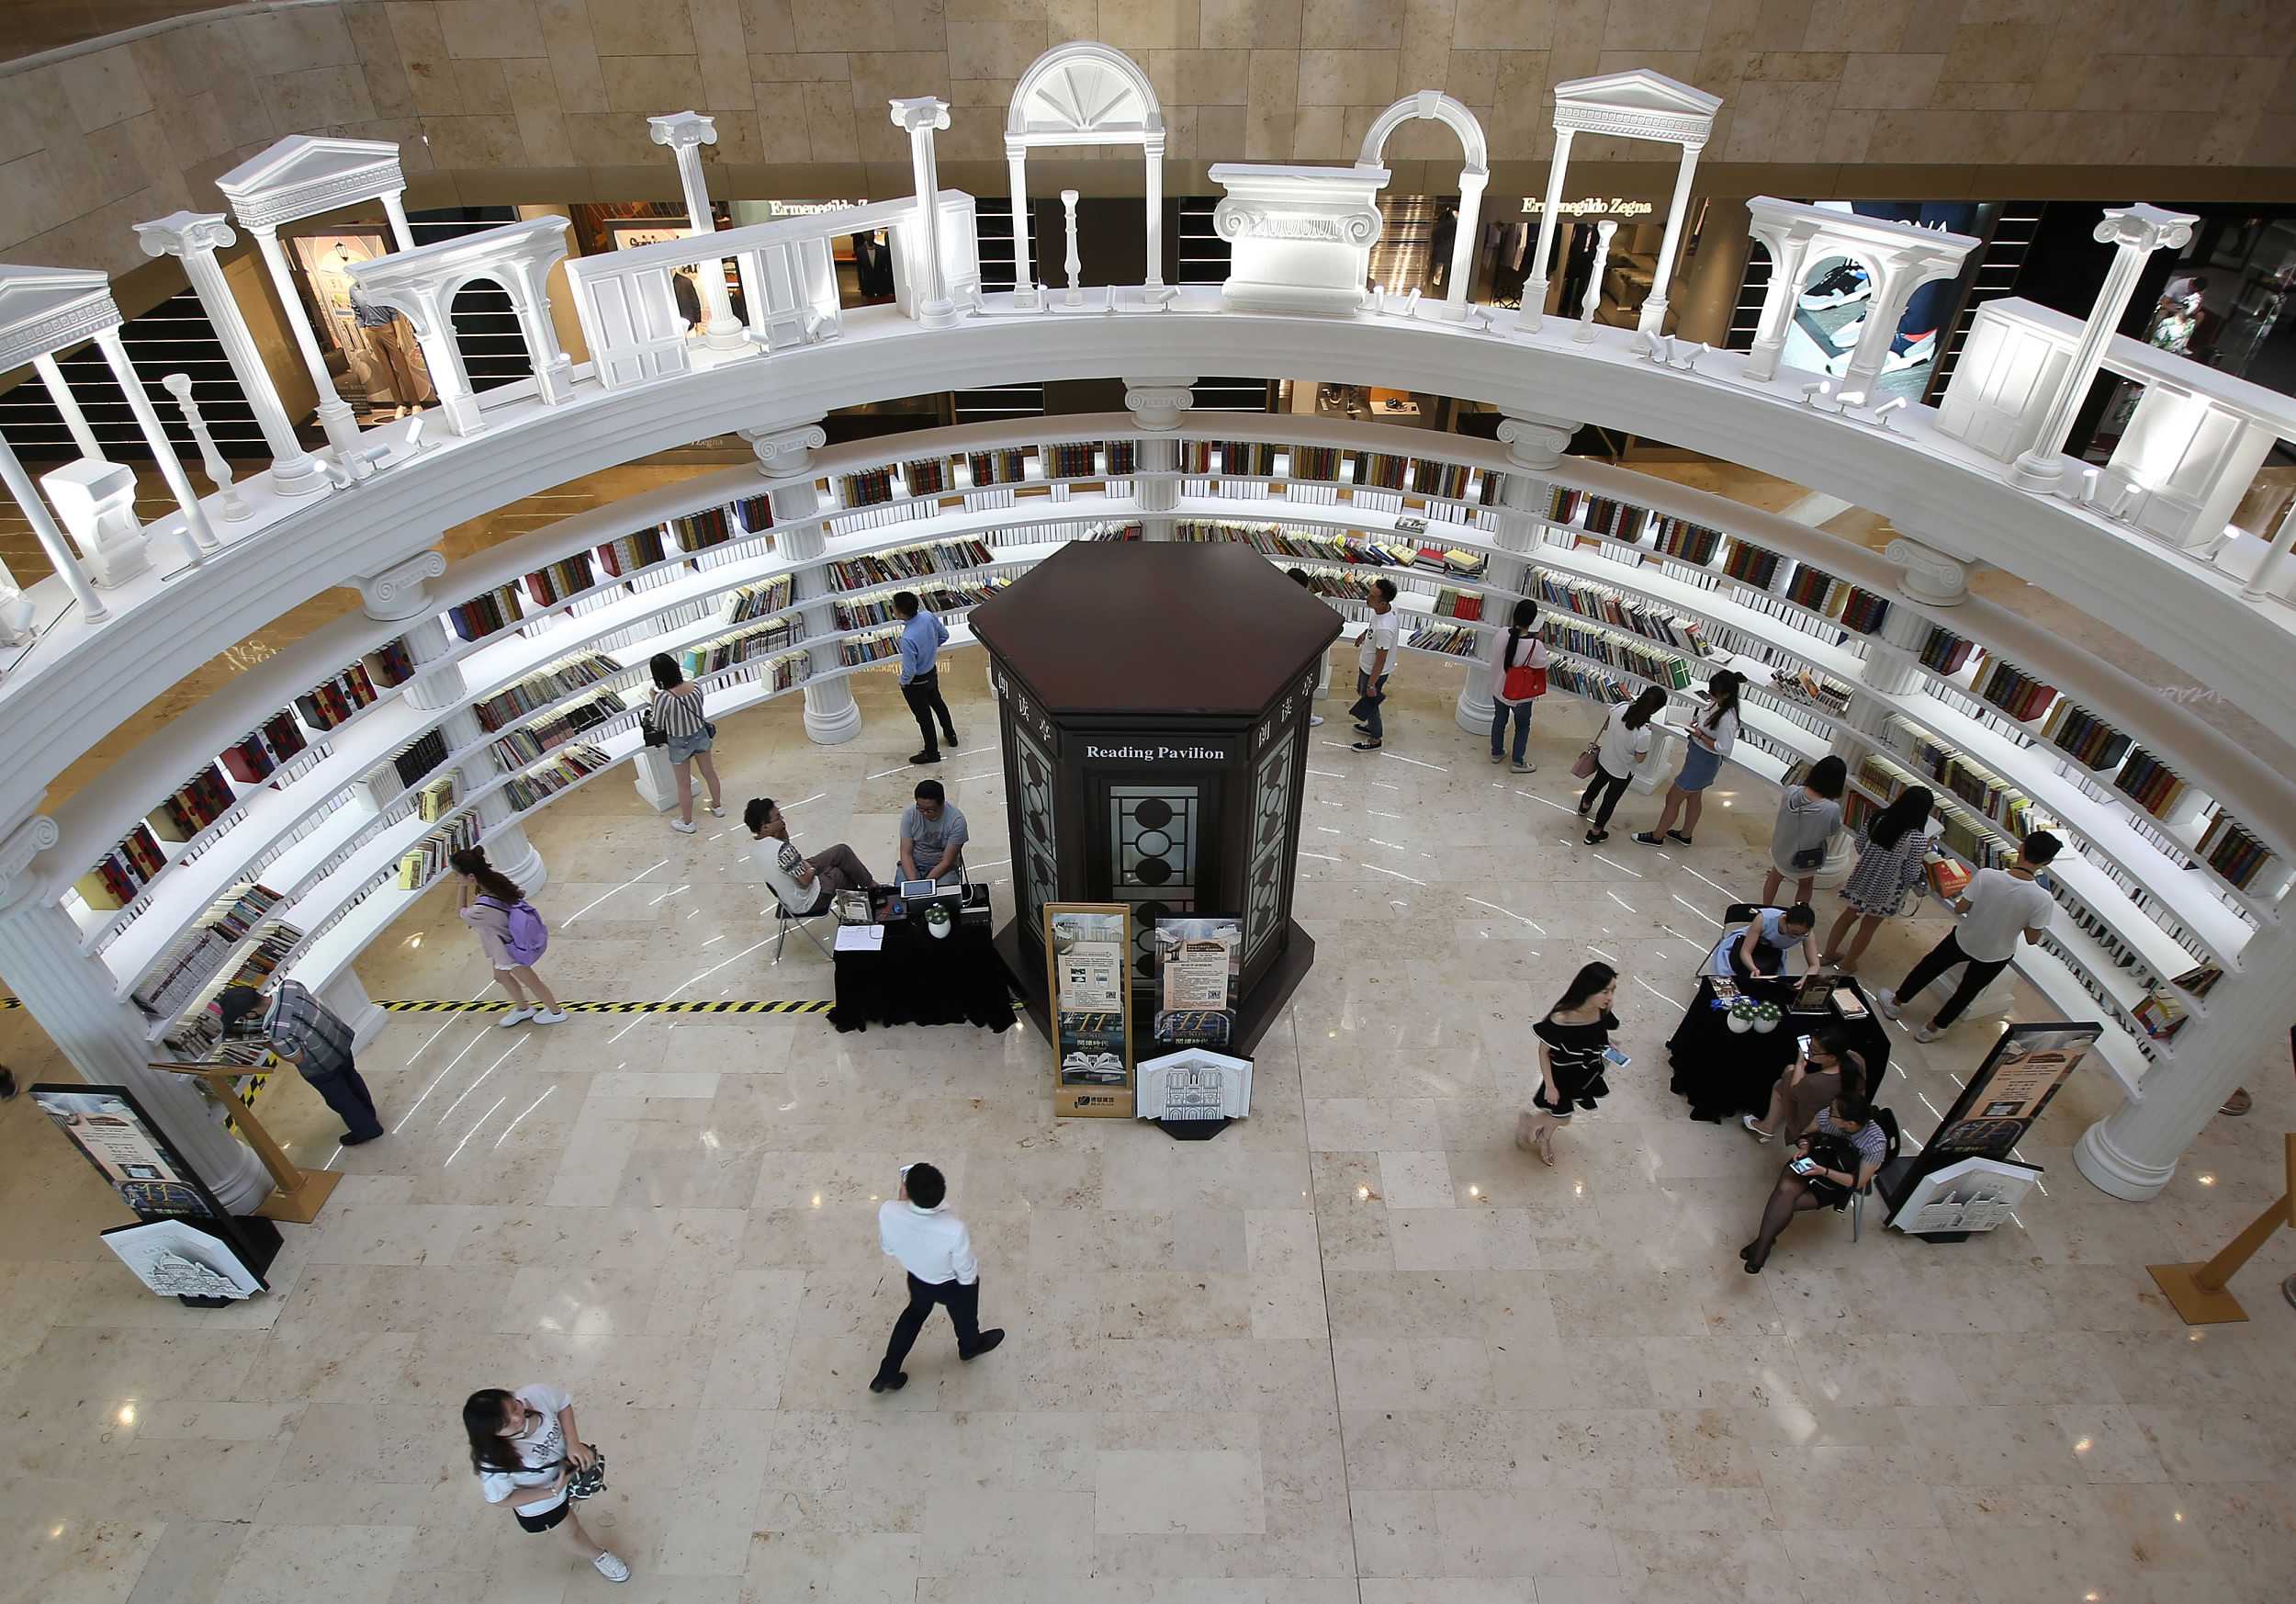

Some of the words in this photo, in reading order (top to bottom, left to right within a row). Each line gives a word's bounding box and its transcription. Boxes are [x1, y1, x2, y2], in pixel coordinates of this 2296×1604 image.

[1521, 198, 1608, 217] Erenegildo
[1608, 198, 1653, 217] Zegna
[1086, 745, 1154, 762] Reading
[1157, 746, 1225, 760] Pavilion
